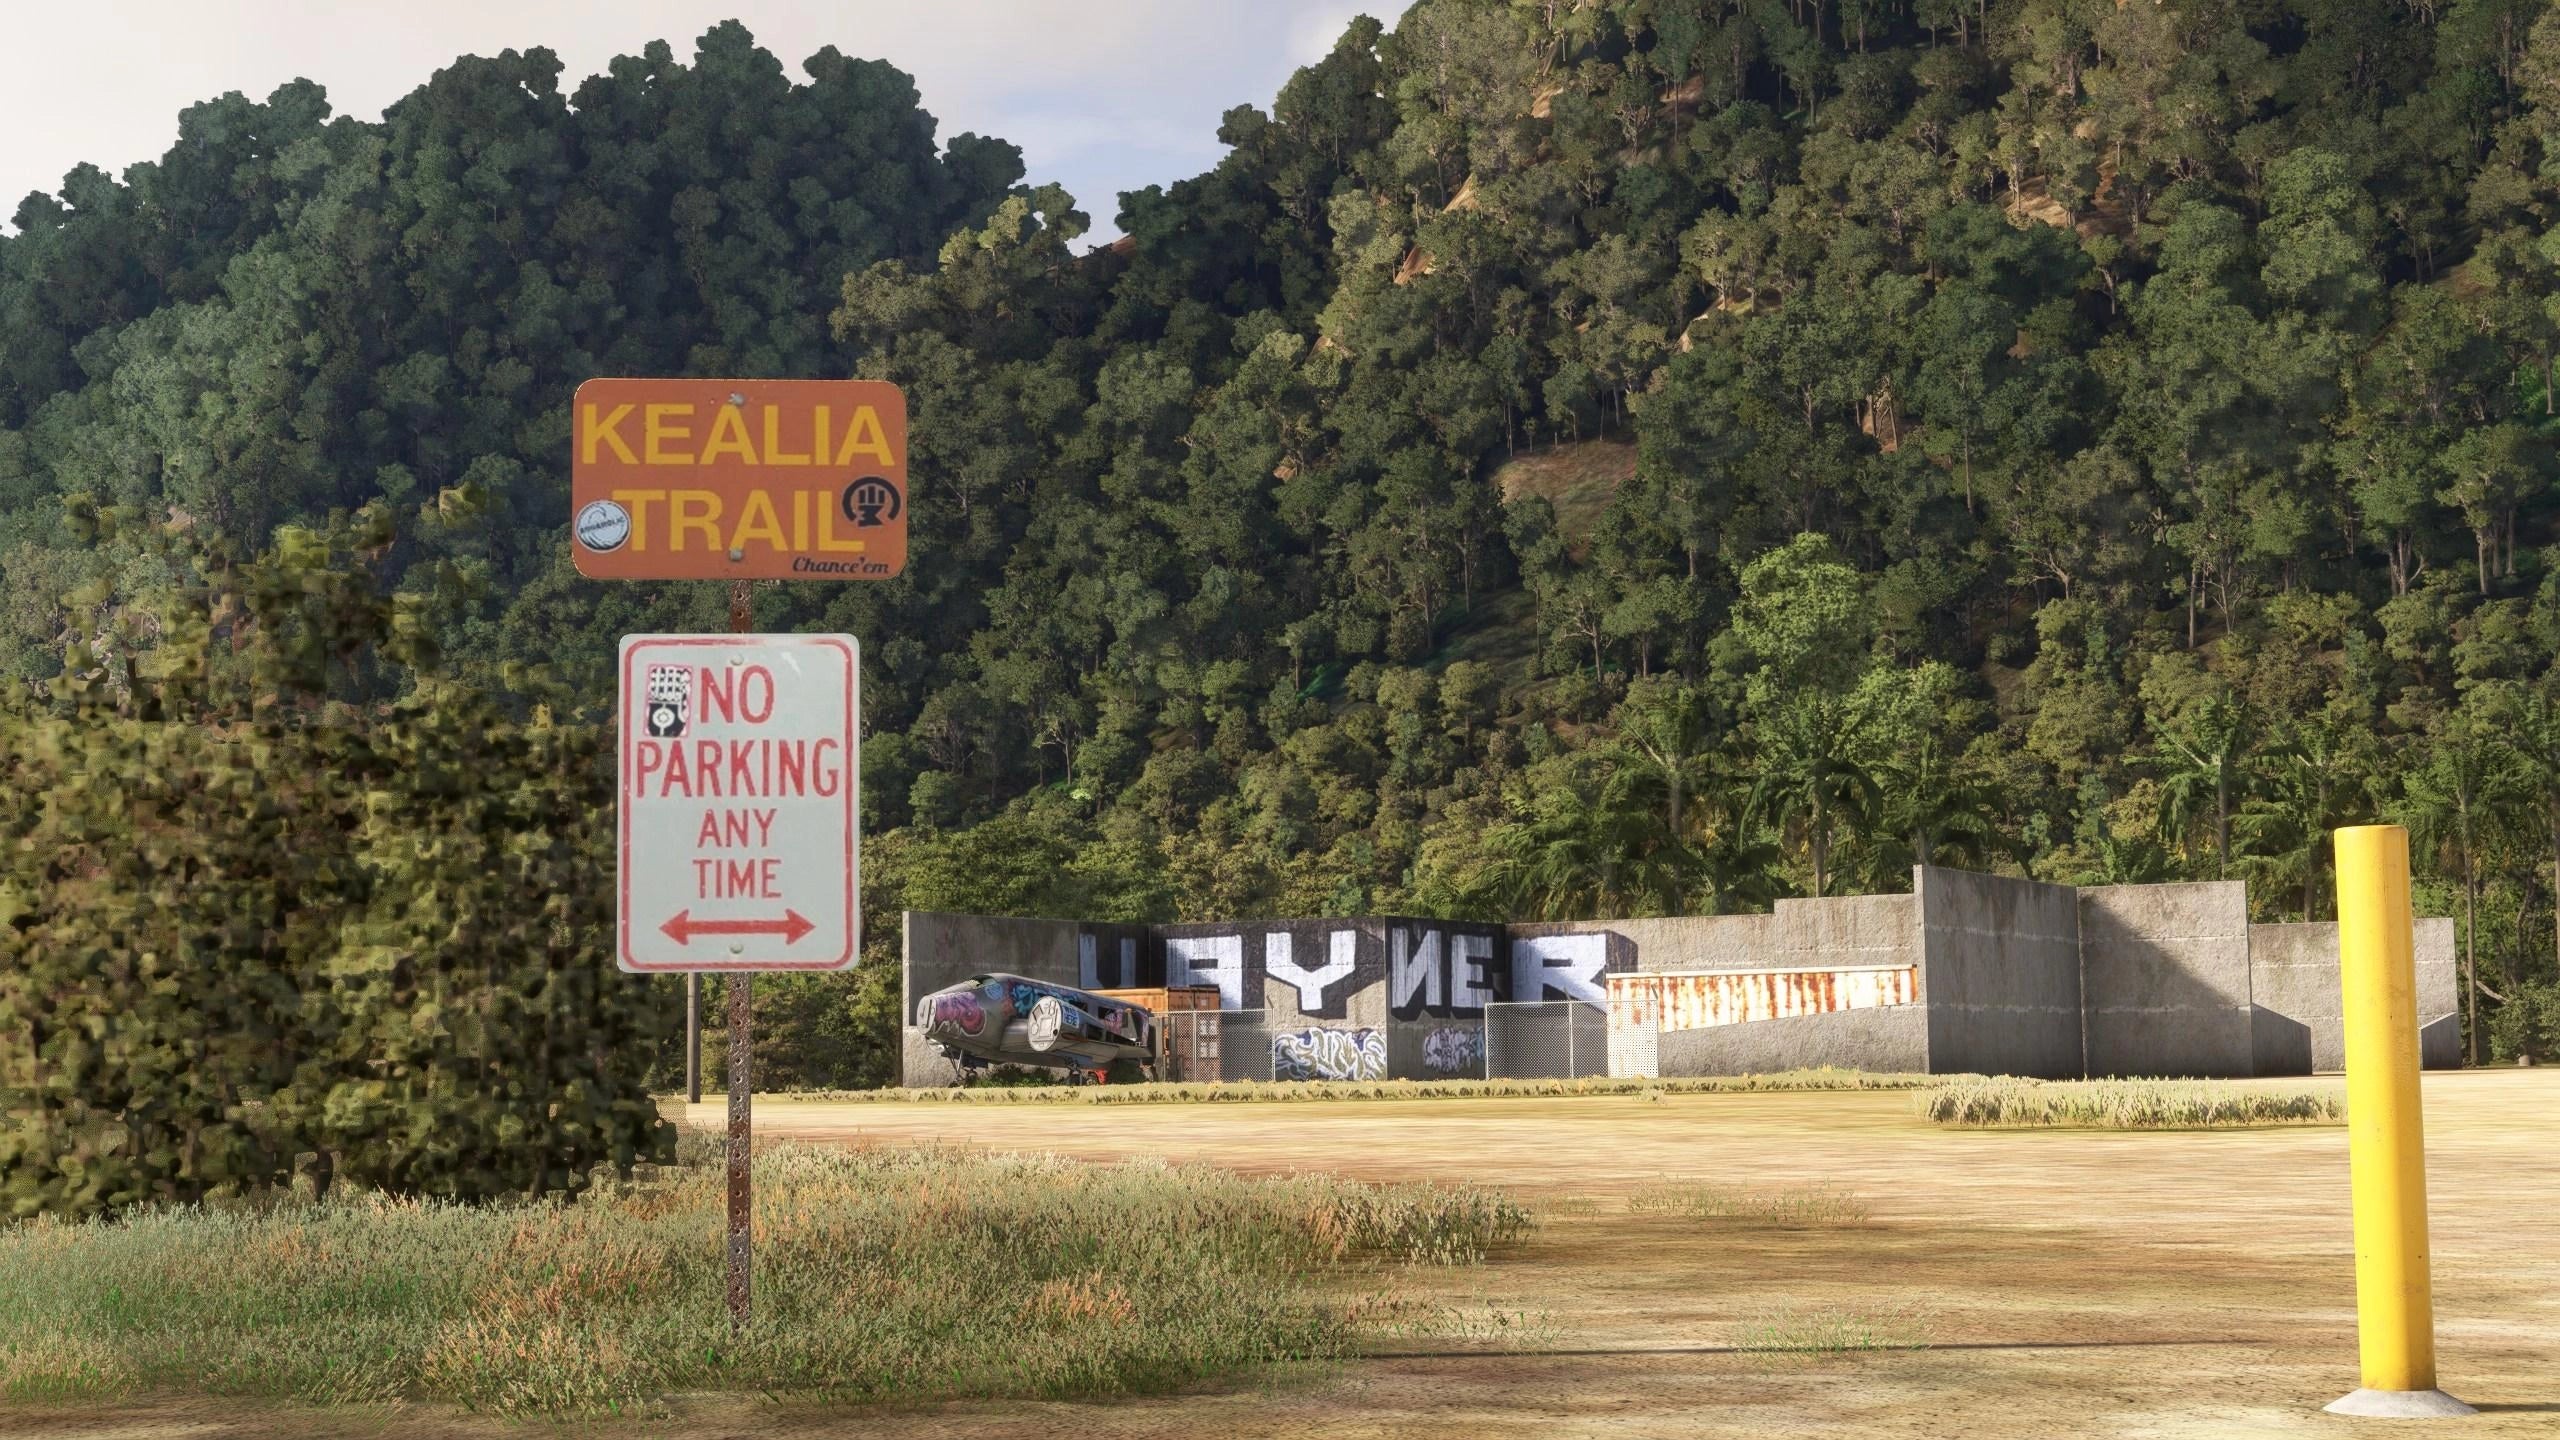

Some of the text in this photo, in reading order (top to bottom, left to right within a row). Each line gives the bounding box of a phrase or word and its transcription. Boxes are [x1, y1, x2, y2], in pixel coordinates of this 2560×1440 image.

[581, 404, 896, 467] KEALIA
[612, 489, 865, 552] TRAIL
[699, 666, 775, 724] NO
[636, 738, 839, 798] PARKING
[697, 808, 778, 848] ANY
[692, 858, 782, 899] TIME
